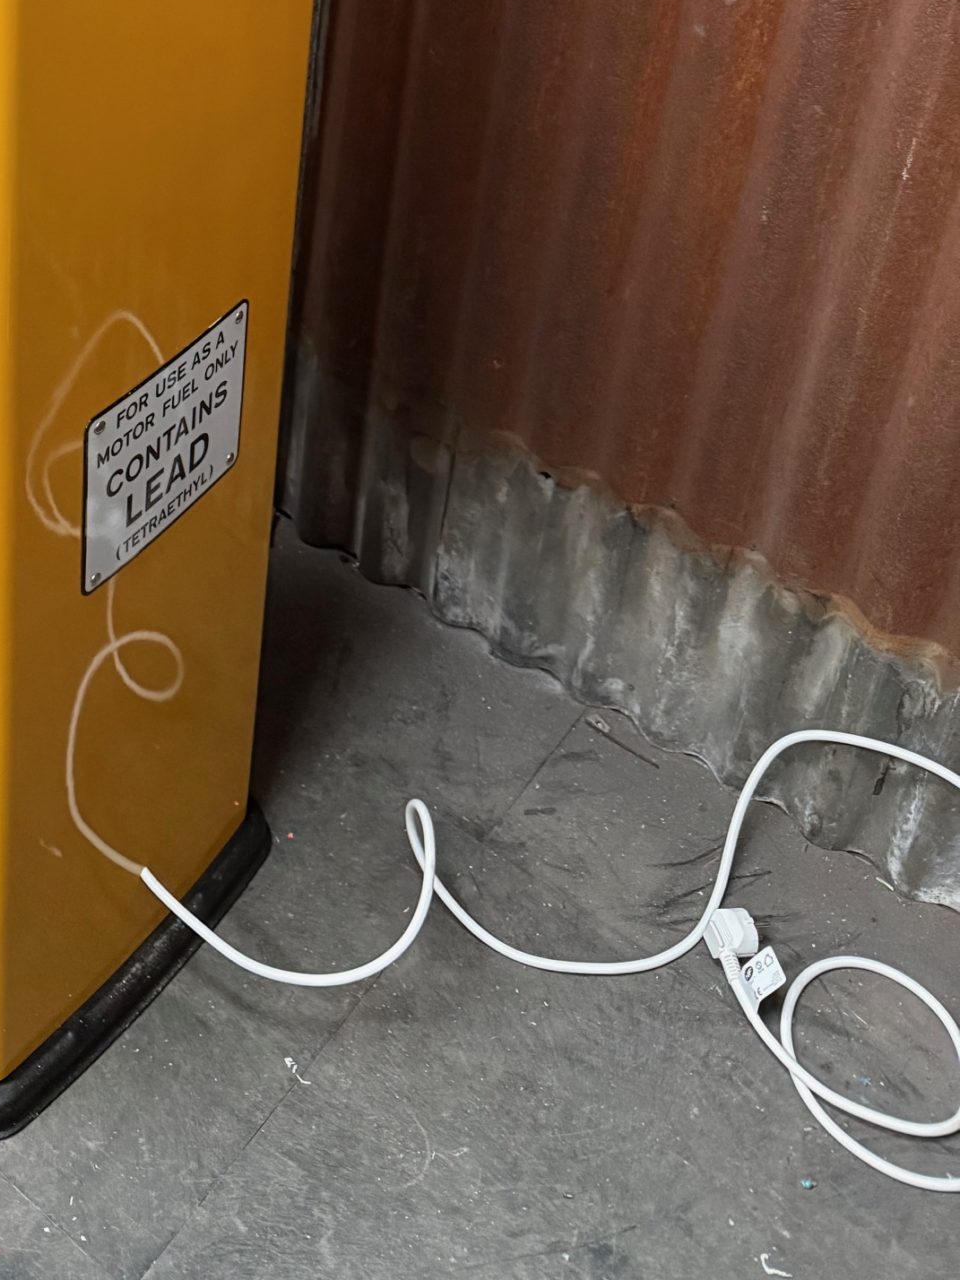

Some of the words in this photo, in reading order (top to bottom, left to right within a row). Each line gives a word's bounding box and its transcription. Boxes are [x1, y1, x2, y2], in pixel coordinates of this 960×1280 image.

[96, 415, 155, 469] MOTOR
[162, 382, 199, 419] FUEL
[204, 340, 239, 382] ONLY
[116, 394, 149, 430] FOR
[155, 369, 187, 399] USE
[192, 345, 211, 372] AS
[215, 330, 226, 351] A
[105, 380, 229, 499] CONTAINS
[125, 432, 210, 527] LEAD
[115, 464, 215, 561] (TETRAETHYL)
